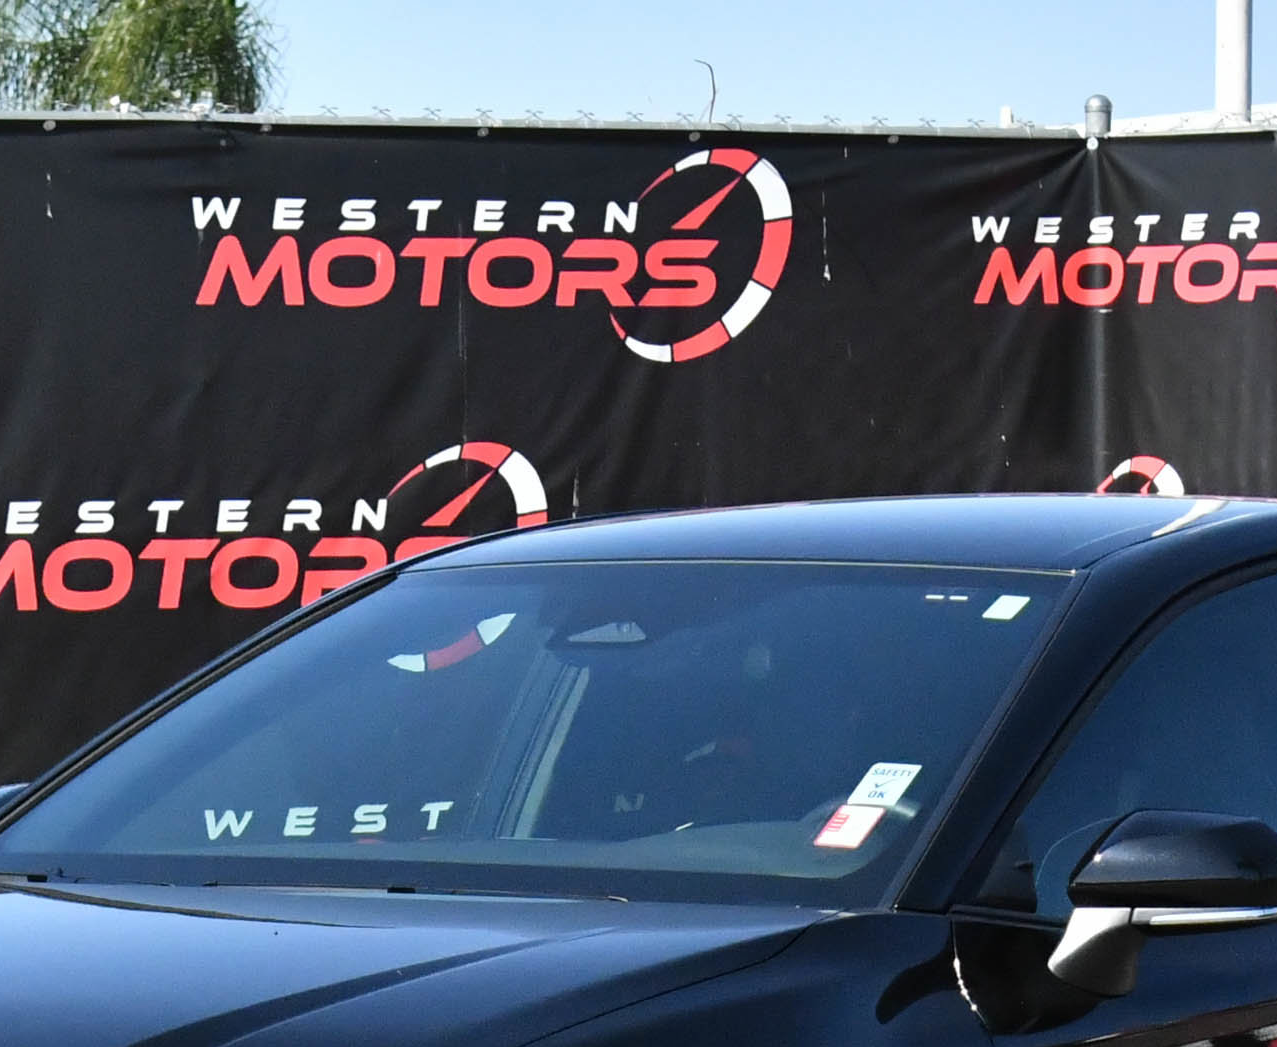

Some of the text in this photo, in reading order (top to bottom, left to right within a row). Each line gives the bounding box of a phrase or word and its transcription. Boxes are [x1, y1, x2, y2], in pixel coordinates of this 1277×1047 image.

[192, 196, 639, 233] WESTERN
[195, 234, 719, 308] MOTORS
[871, 768, 915, 777] SAFETY
[867, 790, 886, 799] OK
